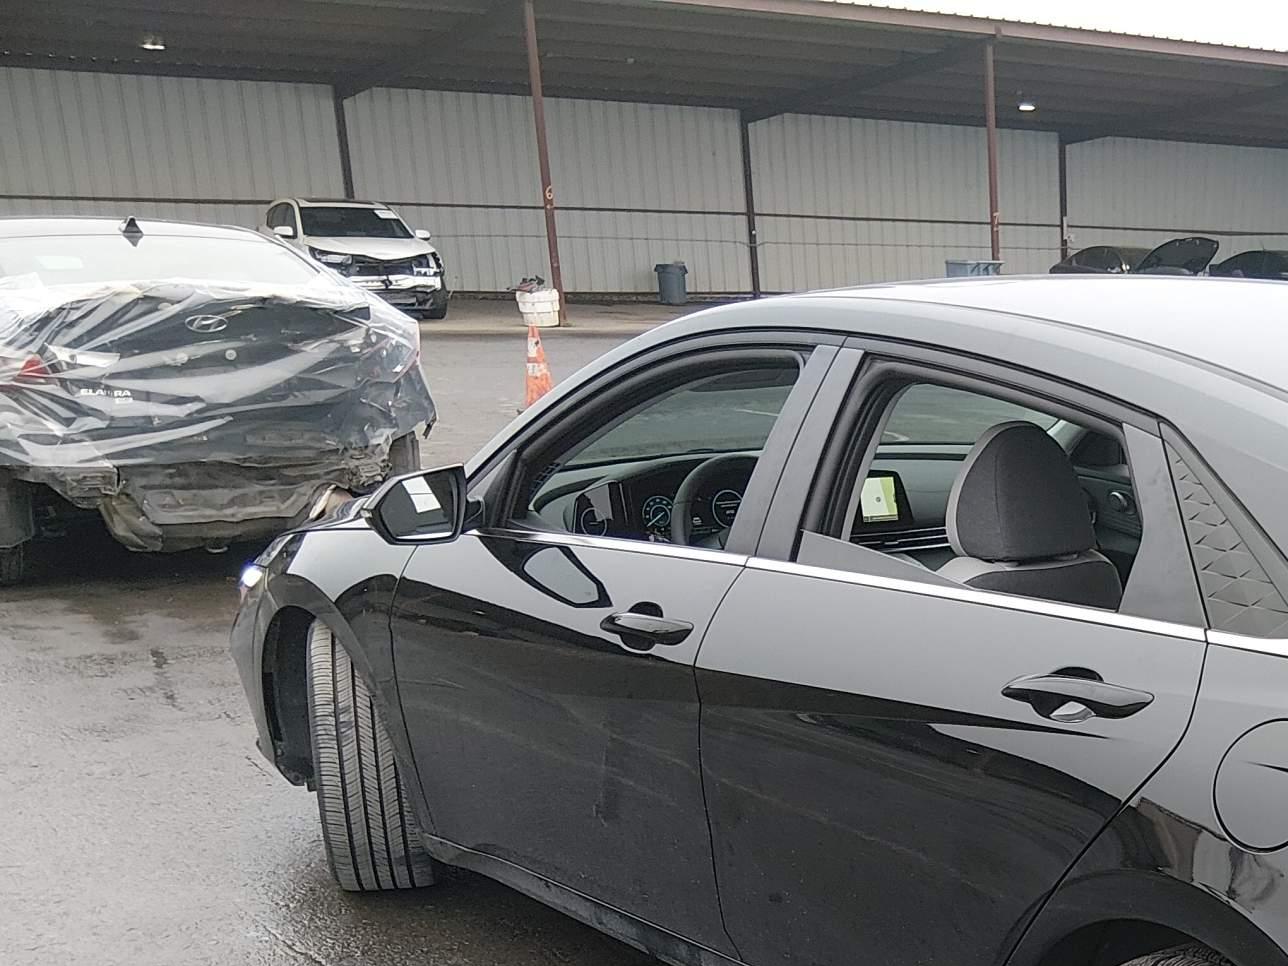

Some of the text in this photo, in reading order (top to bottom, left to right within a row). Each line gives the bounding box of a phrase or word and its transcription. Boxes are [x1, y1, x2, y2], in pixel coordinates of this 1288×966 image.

[545, 185, 554, 200] 6
[992, 211, 1001, 225] 7
[80, 388, 131, 397] ELARA
